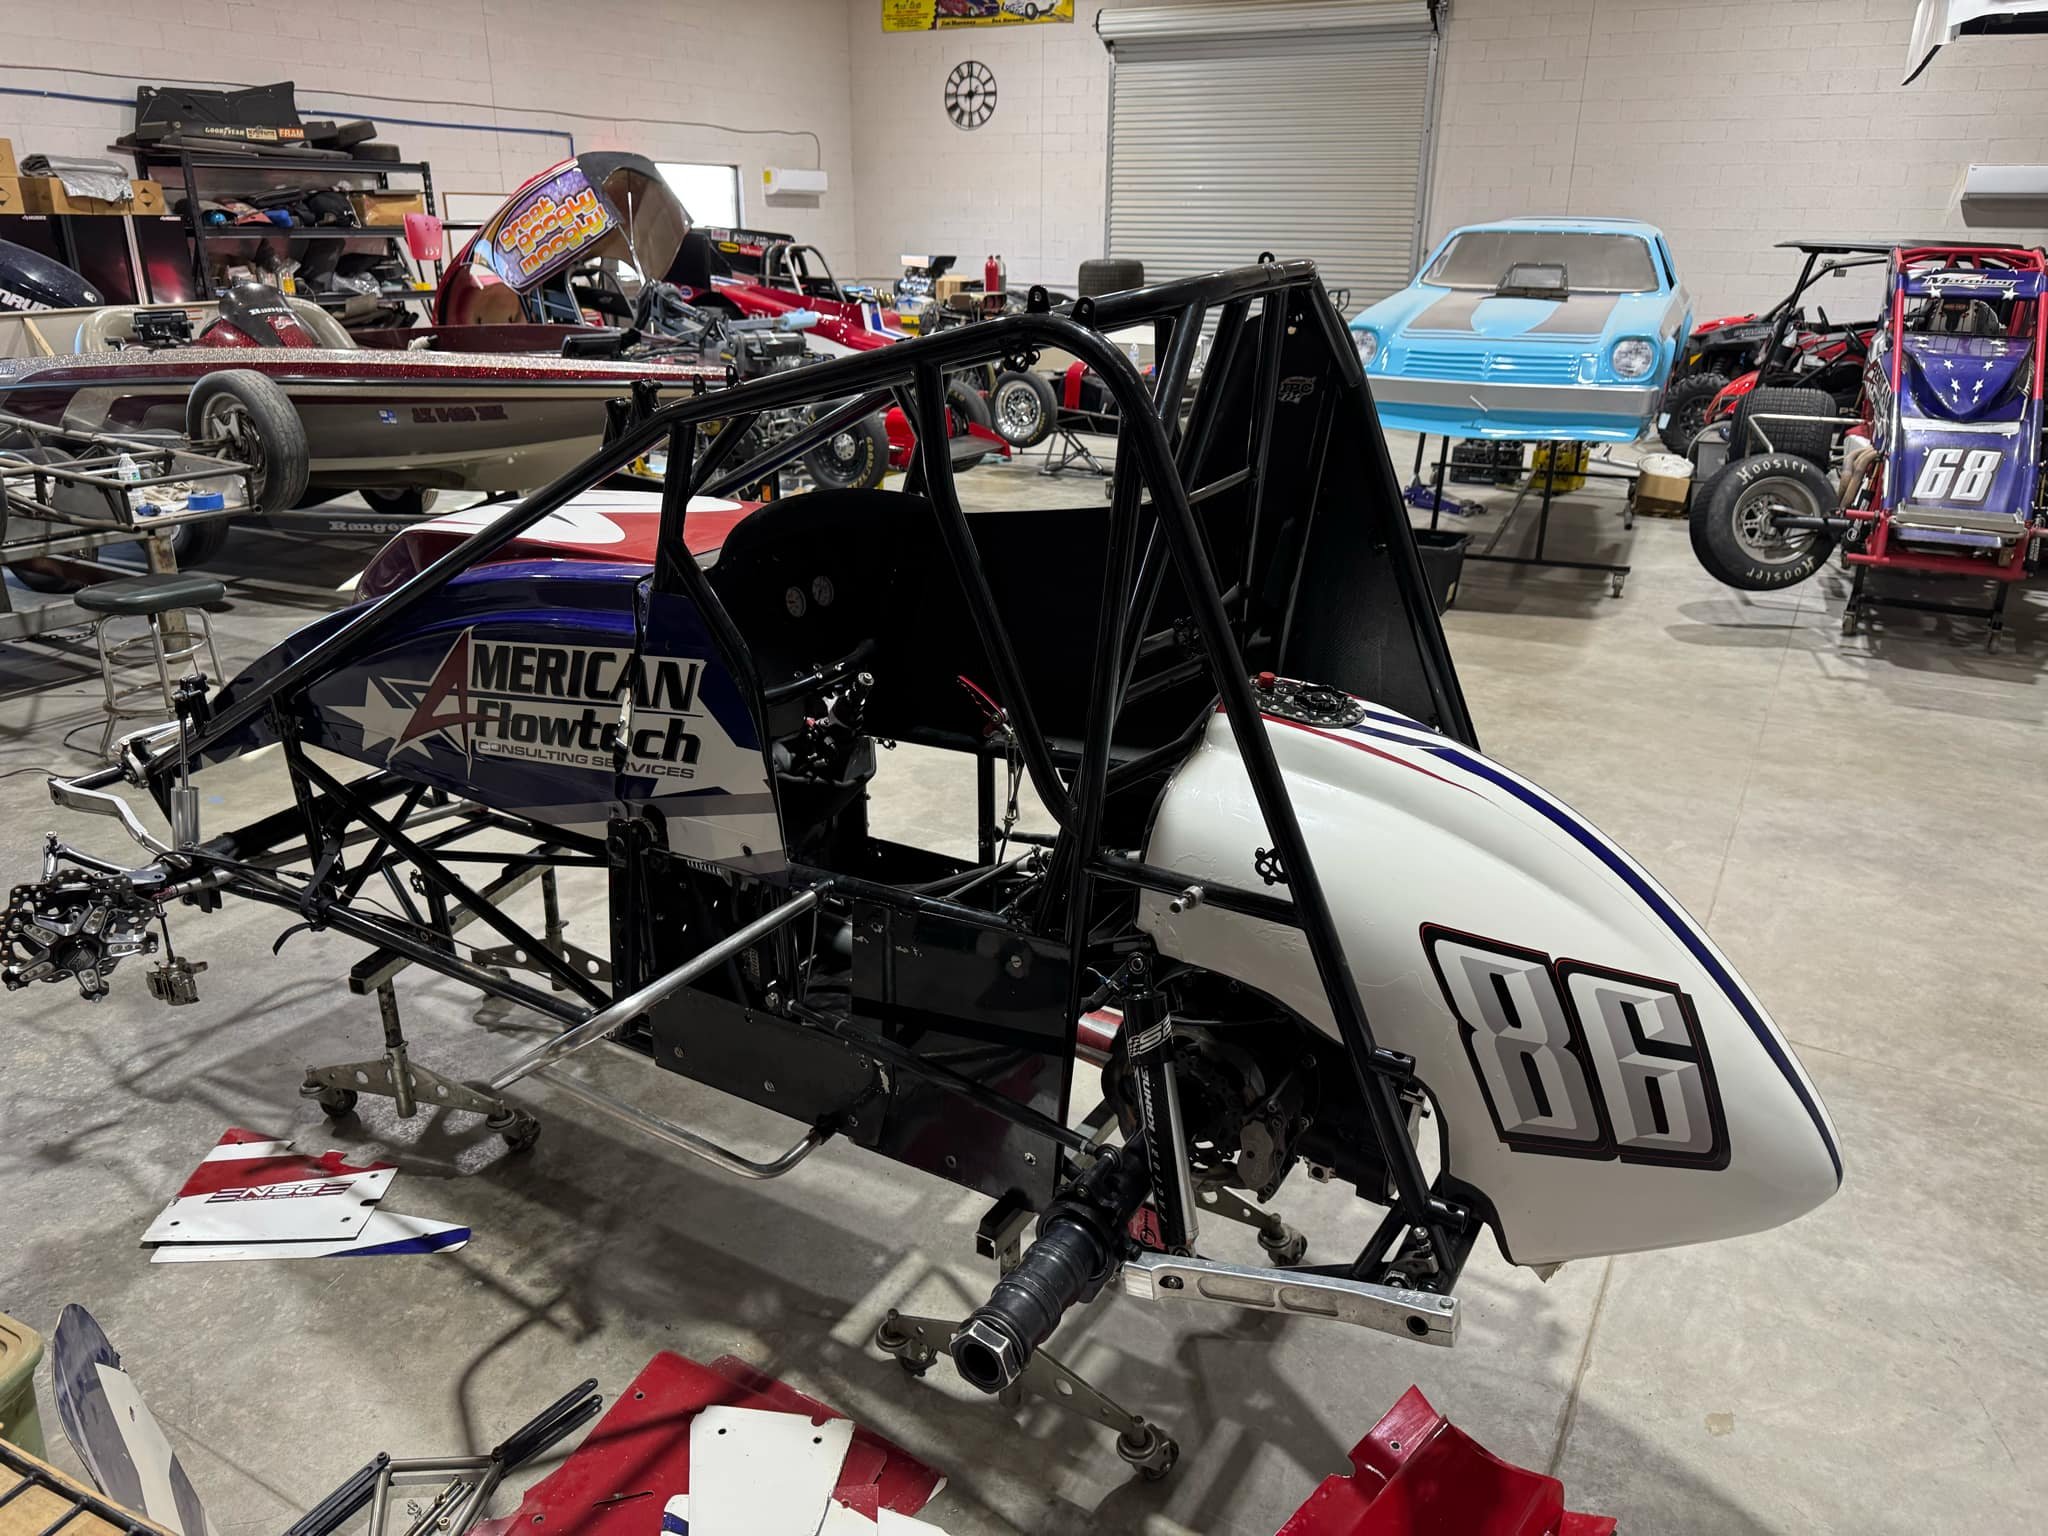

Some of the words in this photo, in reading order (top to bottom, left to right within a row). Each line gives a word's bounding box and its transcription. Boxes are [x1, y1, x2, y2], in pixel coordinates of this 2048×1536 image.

[278, 127, 304, 140] FRAM
[499, 196, 556, 252] great
[517, 187, 598, 256] googly
[519, 203, 610, 276] moogly!
[1911, 448, 2002, 502] 68
[329, 520, 410, 533] Ranger
[478, 741, 589, 766] CONSULTING
[591, 756, 696, 780] SEVICES
[1418, 920, 1732, 1172] 86
[1140, 1069, 1157, 1133] KAHNE
[240, 1183, 326, 1198] NSG
